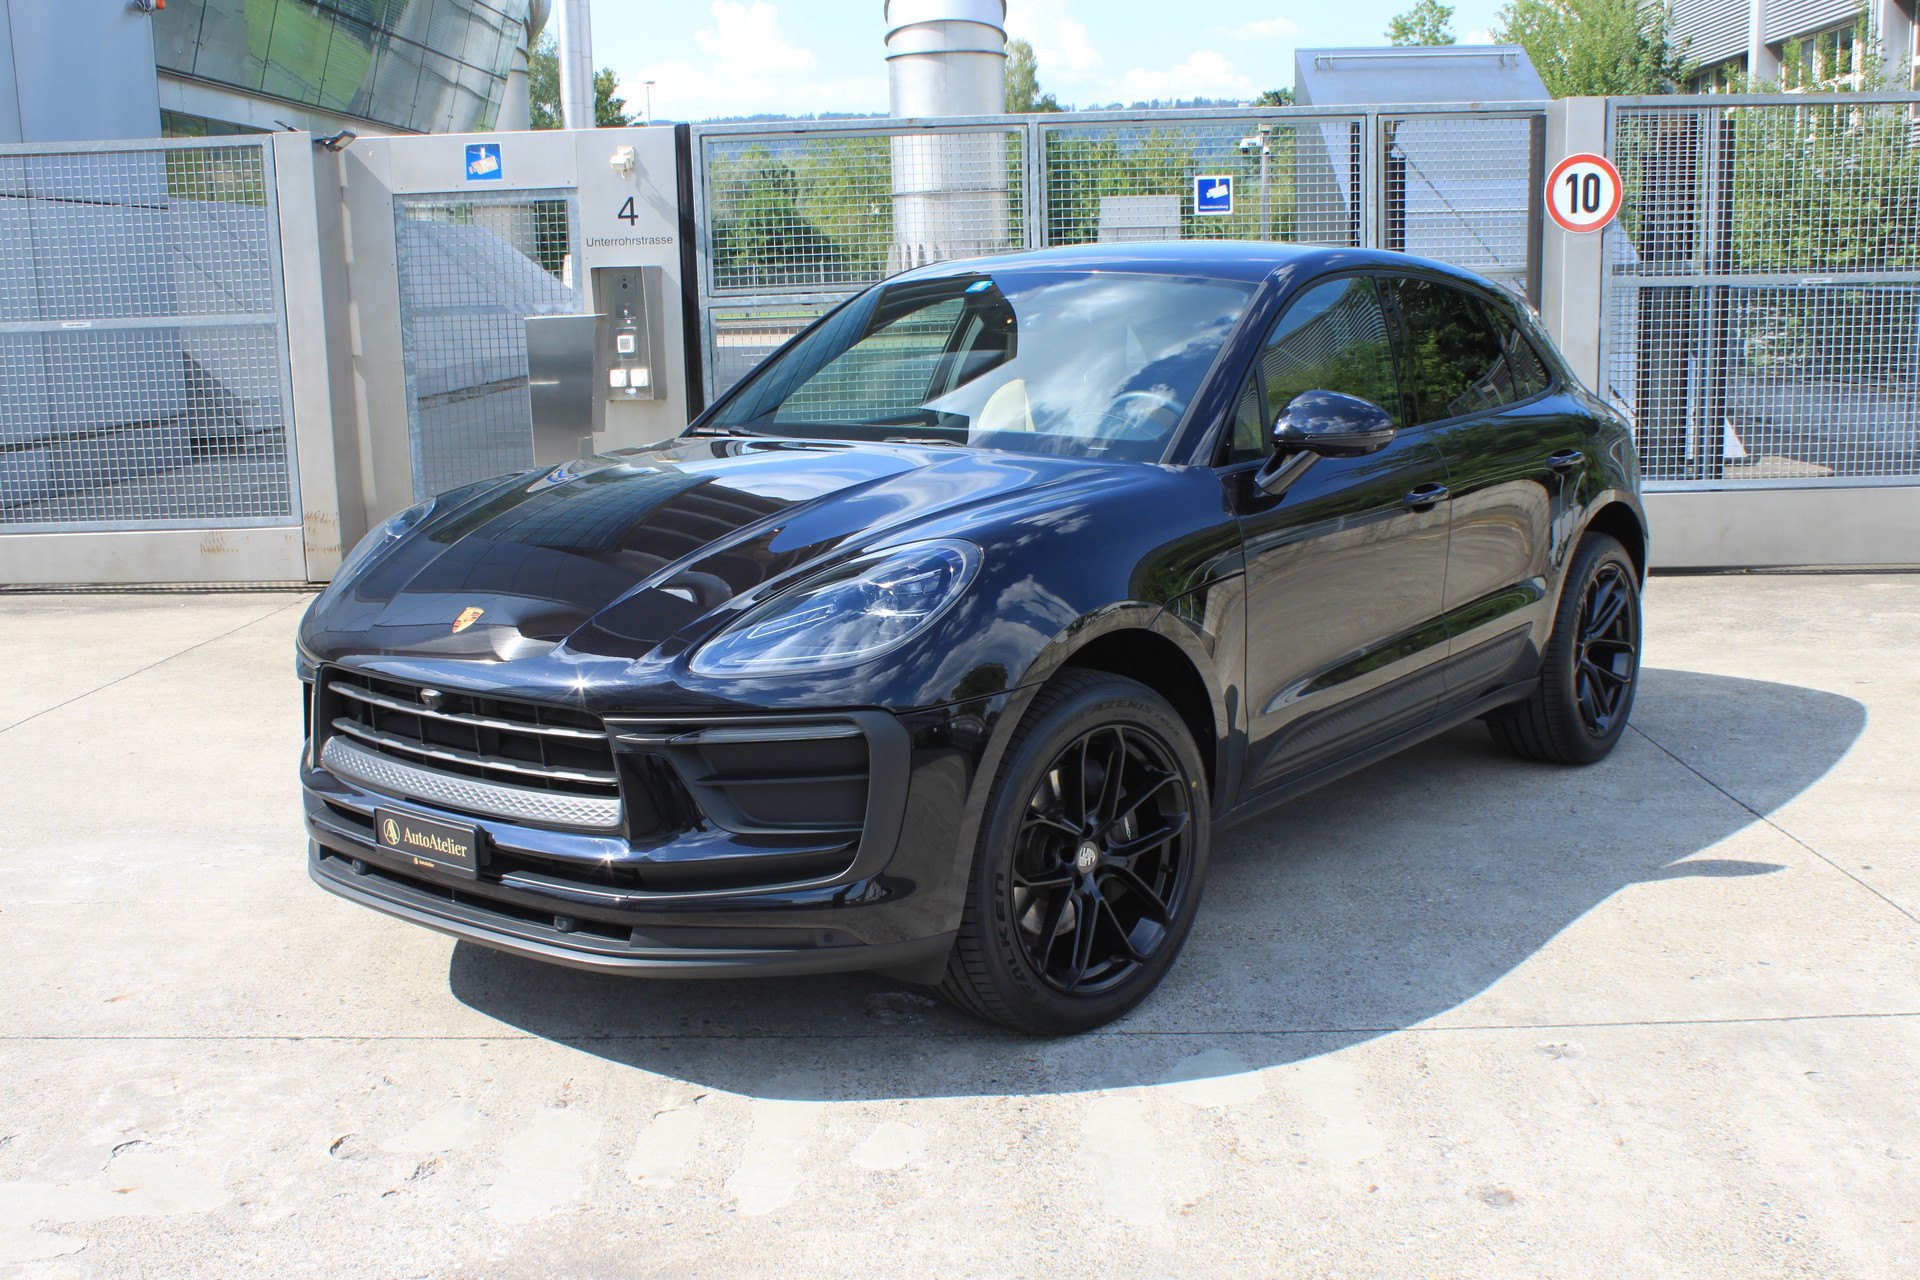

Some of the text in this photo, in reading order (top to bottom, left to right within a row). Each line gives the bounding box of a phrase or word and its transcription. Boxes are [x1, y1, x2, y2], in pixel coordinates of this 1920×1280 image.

[1565, 172, 1601, 214] 10
[617, 197, 638, 226] 4
[586, 236, 673, 247] Unterrohrstrasse
[404, 827, 467, 857] AutoAtelier
